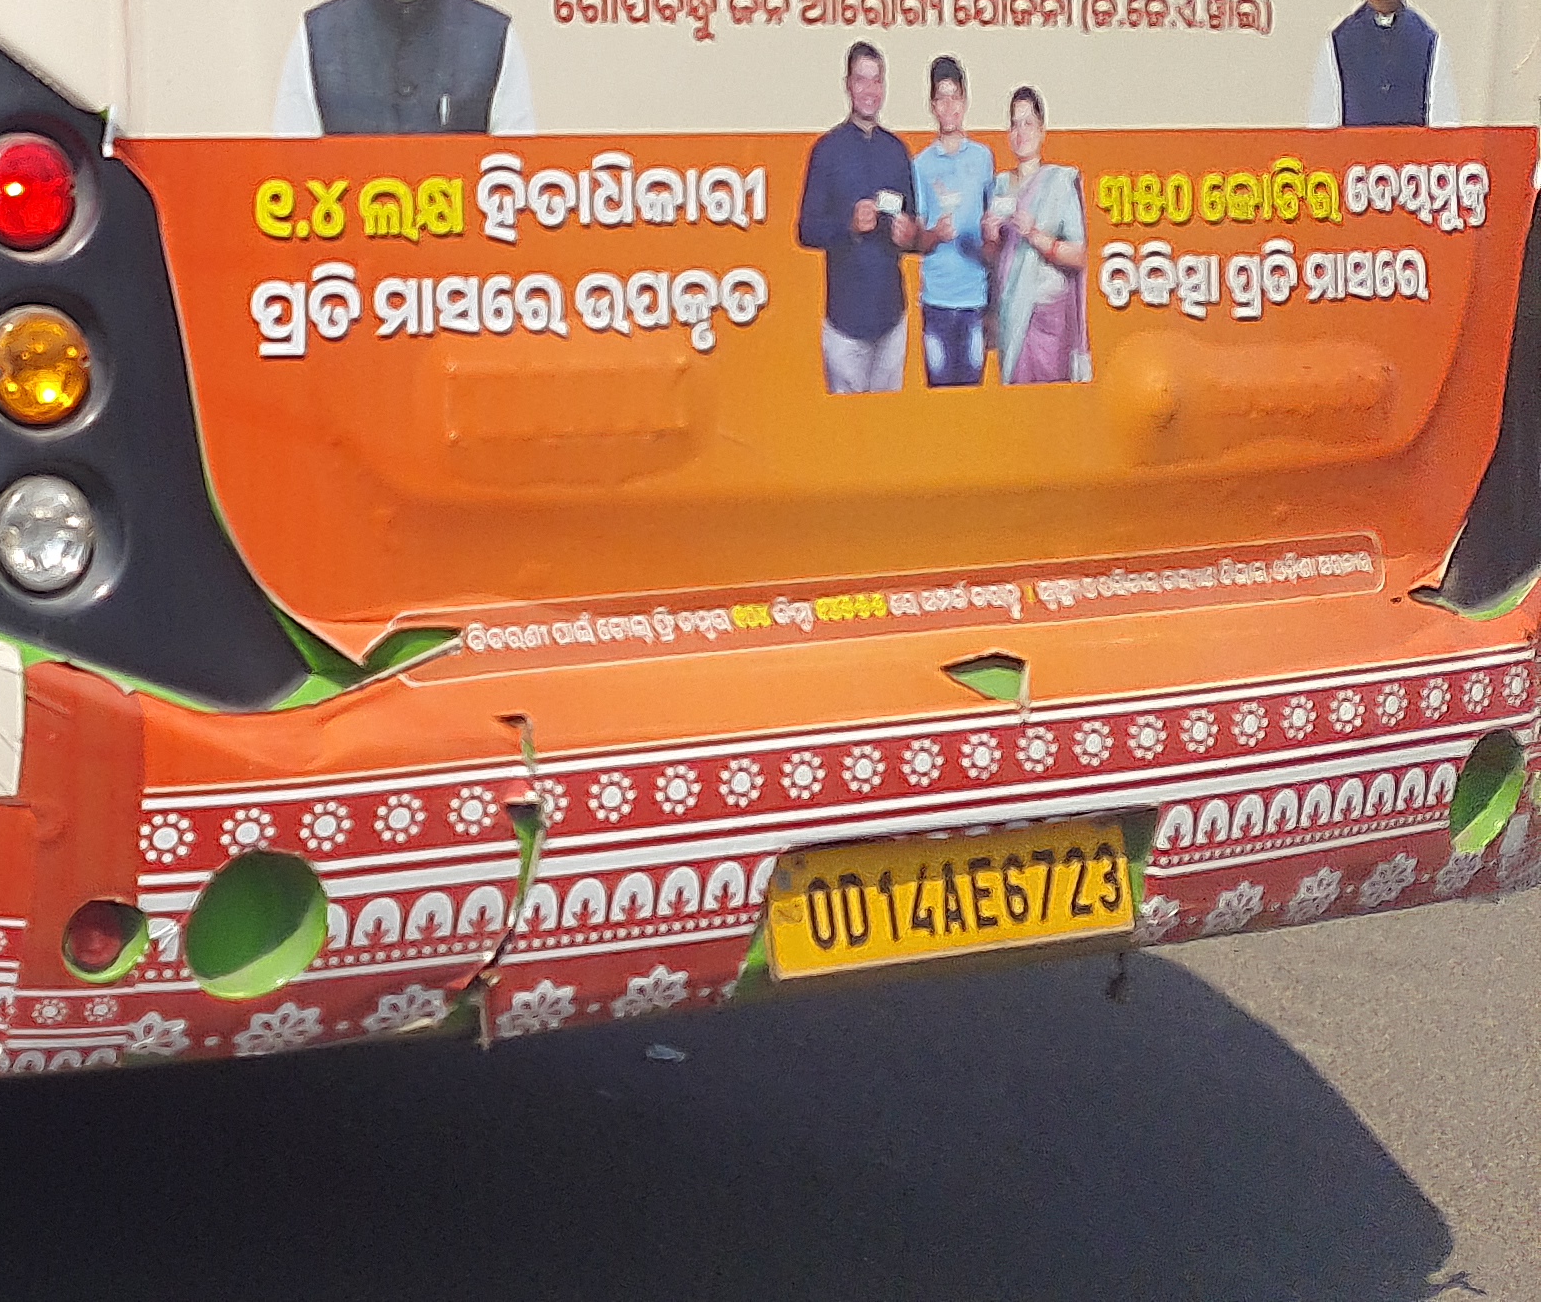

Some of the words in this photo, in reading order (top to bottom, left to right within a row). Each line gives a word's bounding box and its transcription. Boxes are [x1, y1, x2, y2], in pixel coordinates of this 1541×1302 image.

[255, 176, 349, 240] ୧.୪
[358, 176, 465, 244] ଲକ୍ଷ
[477, 151, 767, 243] ହିତାଧିକାରୀ
[1097, 172, 1191, 225] ୩୫୦
[1200, 155, 1344, 225] କୋଟିର
[250, 260, 362, 358] ପ୍ରତି
[373, 271, 568, 338] ମାସରେ
[574, 266, 768, 354] ଉପକୃତ
[1098, 239, 1221, 320] ଚିକିତ୍ସା
[1226, 237, 1298, 320] ପ୍ରତି
[1303, 247, 1430, 302] ମାସରେ
[806, 841, 1123, 951] OD14AE6723
